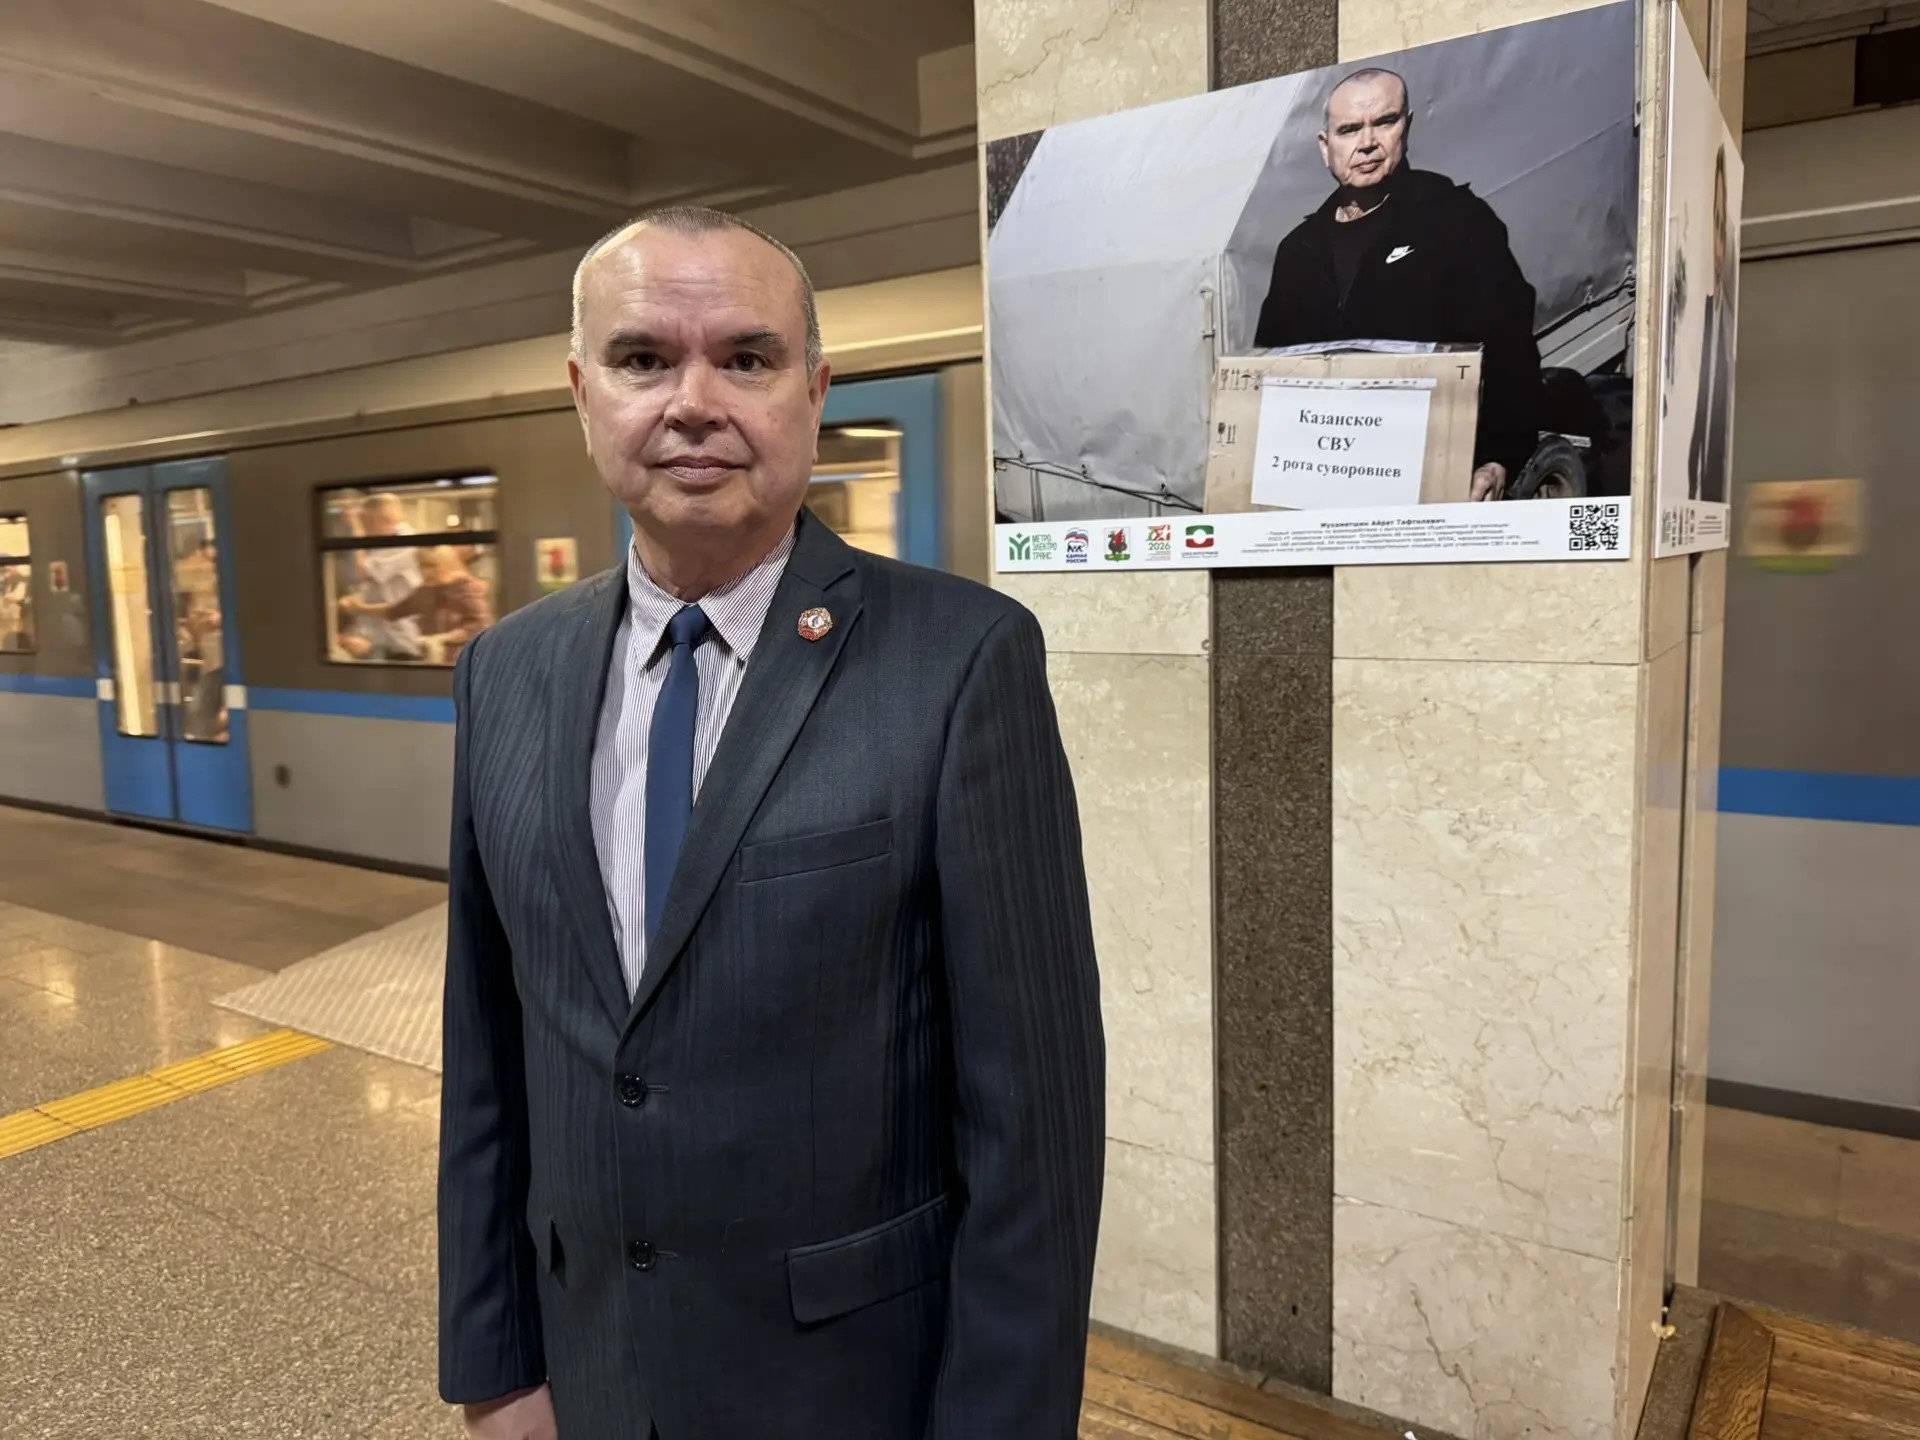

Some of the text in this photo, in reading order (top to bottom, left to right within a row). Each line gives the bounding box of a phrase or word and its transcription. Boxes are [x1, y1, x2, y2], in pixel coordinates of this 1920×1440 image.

[1299, 409, 1383, 427] Казанское
[1317, 436, 1356, 451] СВУ
[1272, 456, 1401, 478] 2 рота суворовцев
[1148, 542, 1171, 551] 2026
